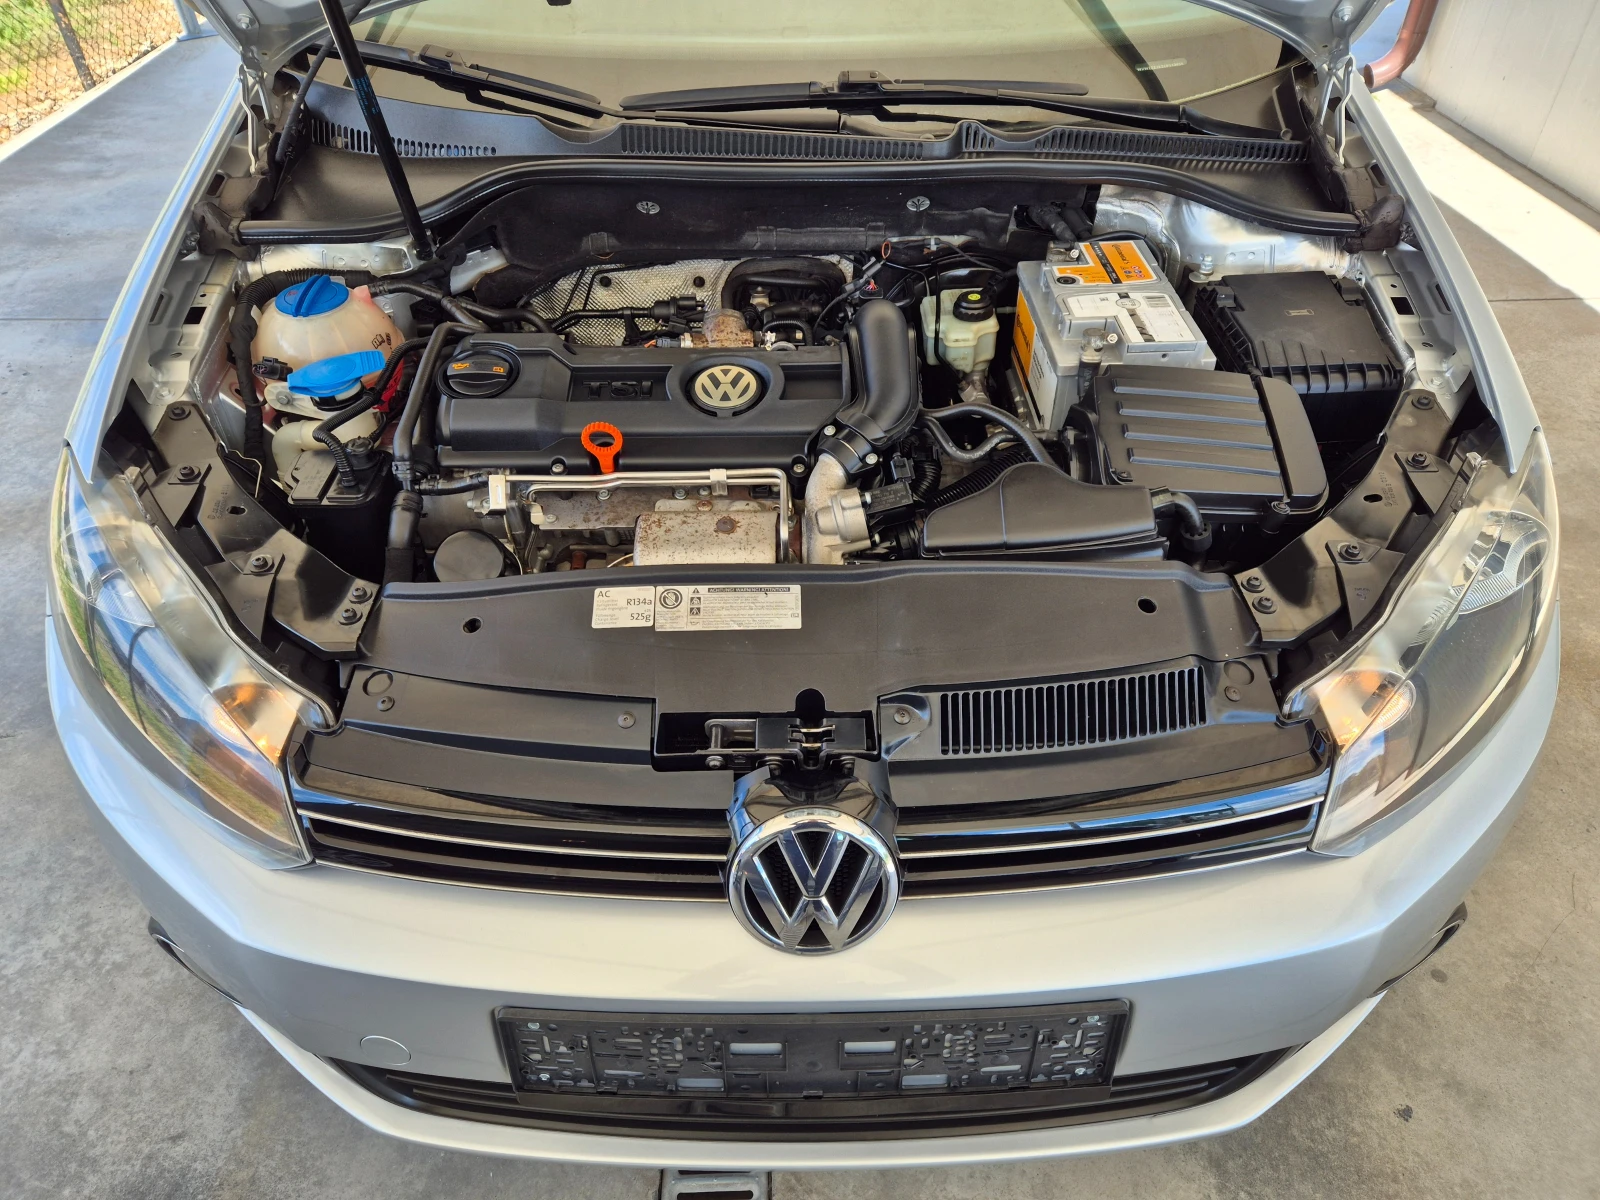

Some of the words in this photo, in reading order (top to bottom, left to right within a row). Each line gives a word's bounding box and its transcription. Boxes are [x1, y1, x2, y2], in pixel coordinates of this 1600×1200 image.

[582, 380, 653, 398] TSI
[695, 365, 757, 407] VW
[597, 590, 611, 598] AC
[626, 598, 652, 606] R134a
[630, 612, 651, 622] 525g
[737, 827, 891, 952] VW
